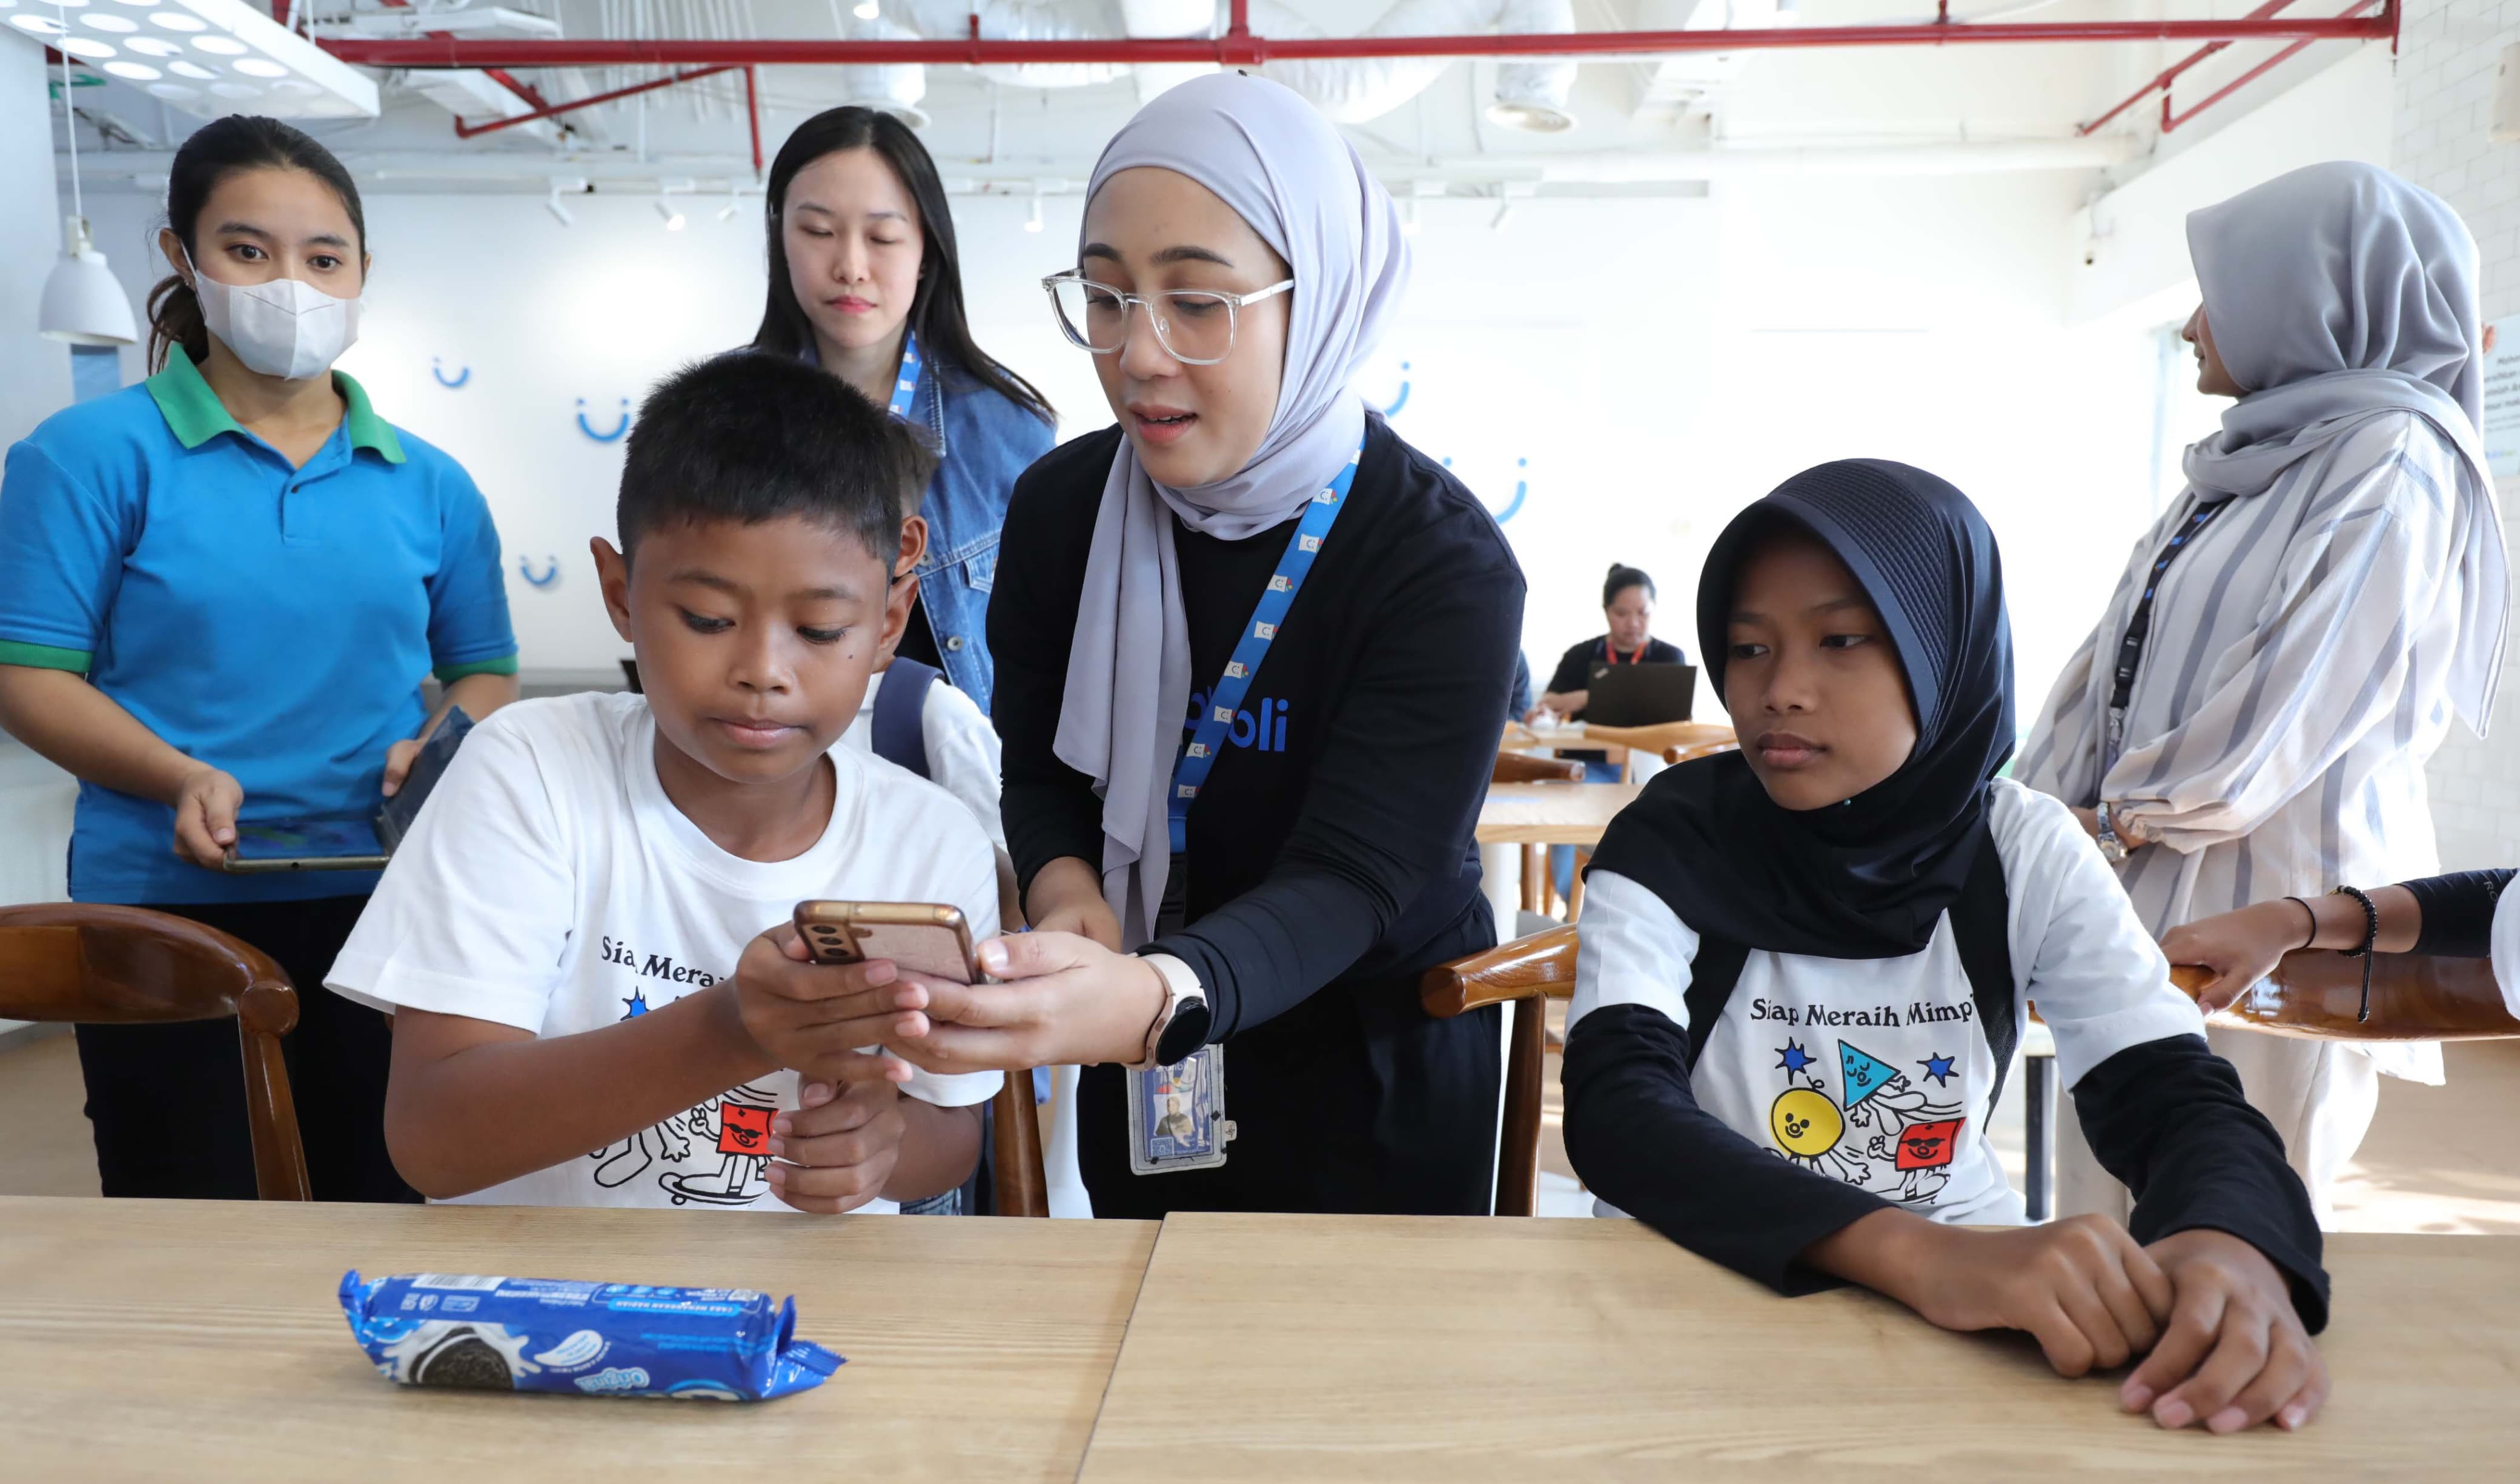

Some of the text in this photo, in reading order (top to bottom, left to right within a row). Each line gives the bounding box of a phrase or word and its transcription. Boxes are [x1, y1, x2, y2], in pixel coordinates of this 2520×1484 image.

[1750, 993, 1974, 1027] Siap Meraih Mimp
